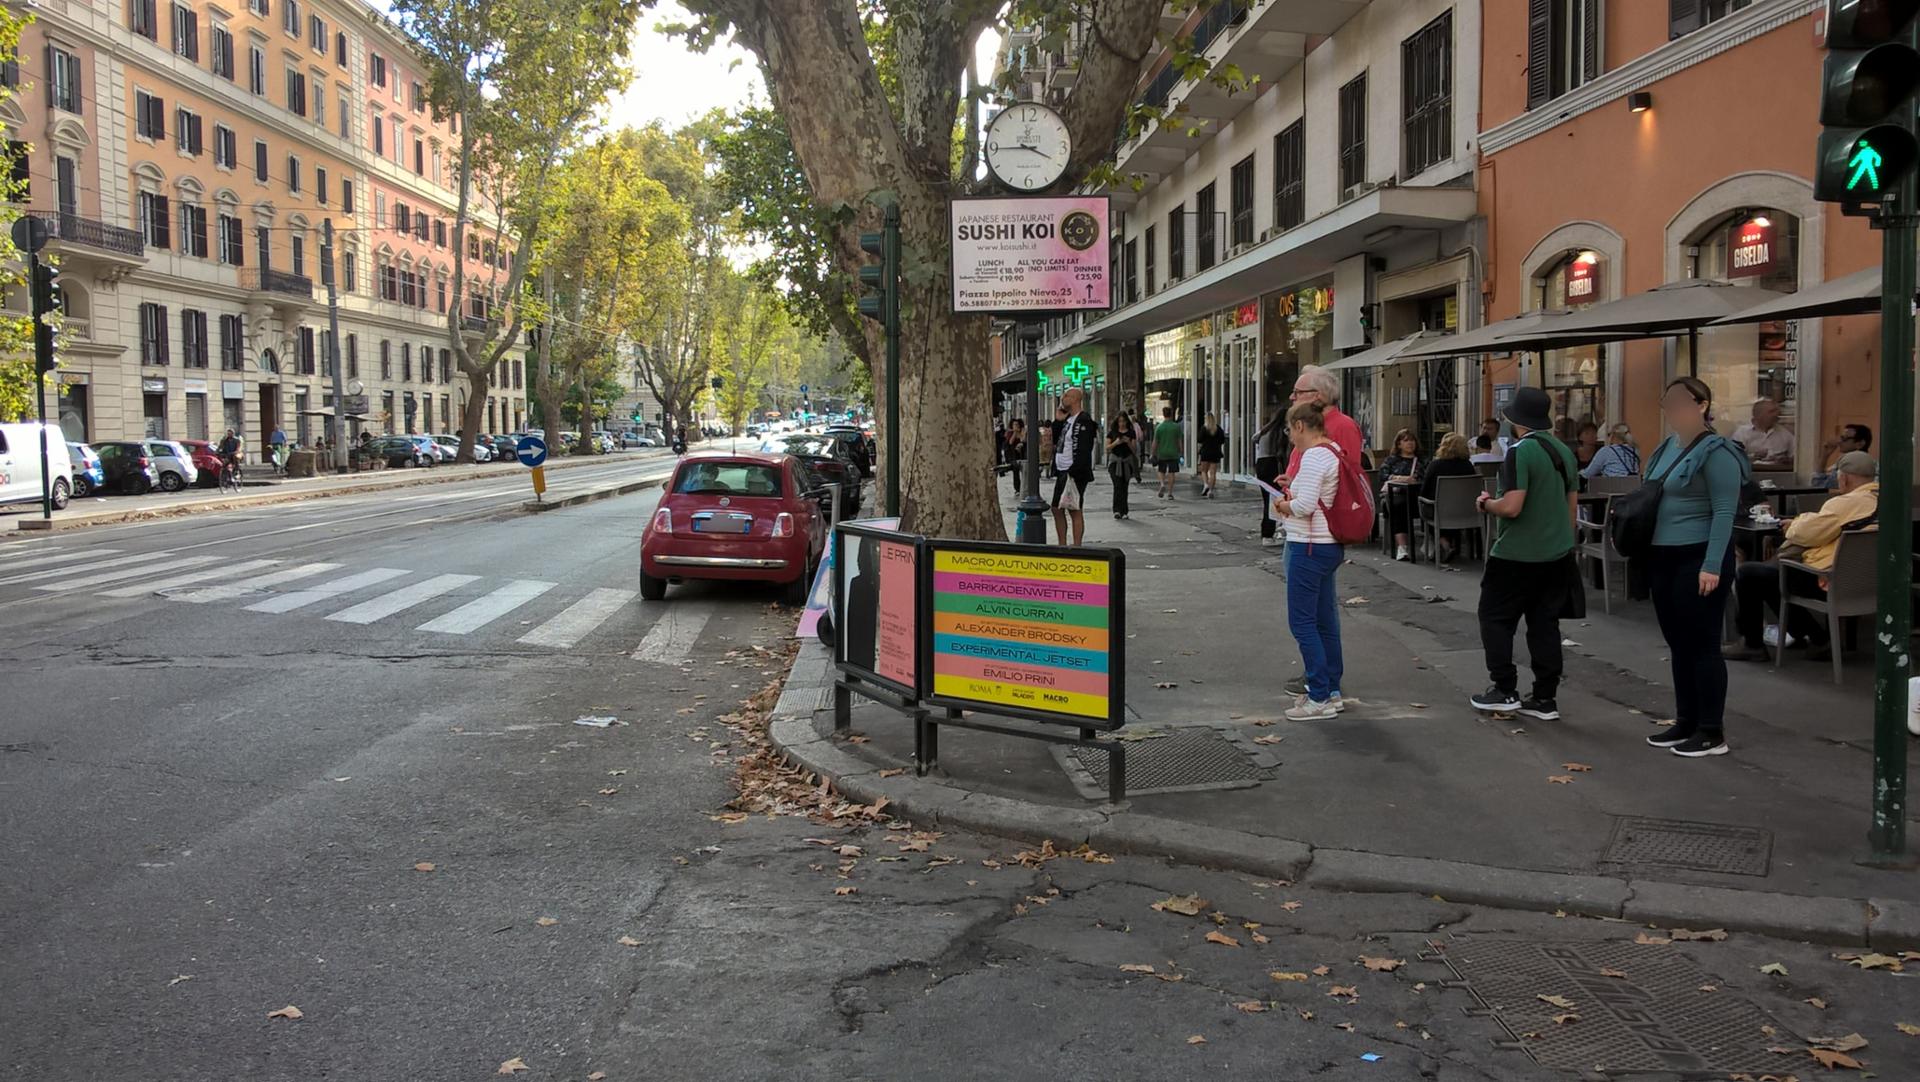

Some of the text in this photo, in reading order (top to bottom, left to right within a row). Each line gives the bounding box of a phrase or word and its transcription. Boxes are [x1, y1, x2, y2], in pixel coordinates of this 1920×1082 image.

[1022, 108, 1038, 122] 12
[989, 142, 999, 155] 9
[1059, 141, 1068, 155] 3
[1024, 174, 1033, 188] 6
[959, 213, 1055, 224] JAPANESE RESTAURANT
[958, 223, 1055, 240] SUSHI KOI
[978, 259, 1004, 267] LUNCH
[1734, 243, 1769, 269] GISELDA
[960, 290, 990, 298] Piazza
[993, 289, 1027, 300] Ippolito
[1569, 277, 1592, 297] GISELDA
[952, 556, 996, 567] MACRO
[998, 559, 1058, 572] AUTUNNO
[1060, 564, 1092, 575] 2023
[958, 581, 1084, 601] BARRIKADENWETTER
[976, 604, 1011, 615] ALVIN
[1012, 607, 1064, 620] CURRAN
[955, 623, 1026, 638] ALEXANDER
[1028, 631, 1087, 645] BRODSKY
[951, 643, 1040, 662] EXPERIMENTAL
[1043, 654, 1092, 667] JETSET
[983, 668, 1023, 682] EMILIO
[1025, 674, 1056, 686] PRINI
[1043, 694, 1069, 703] MACRO
